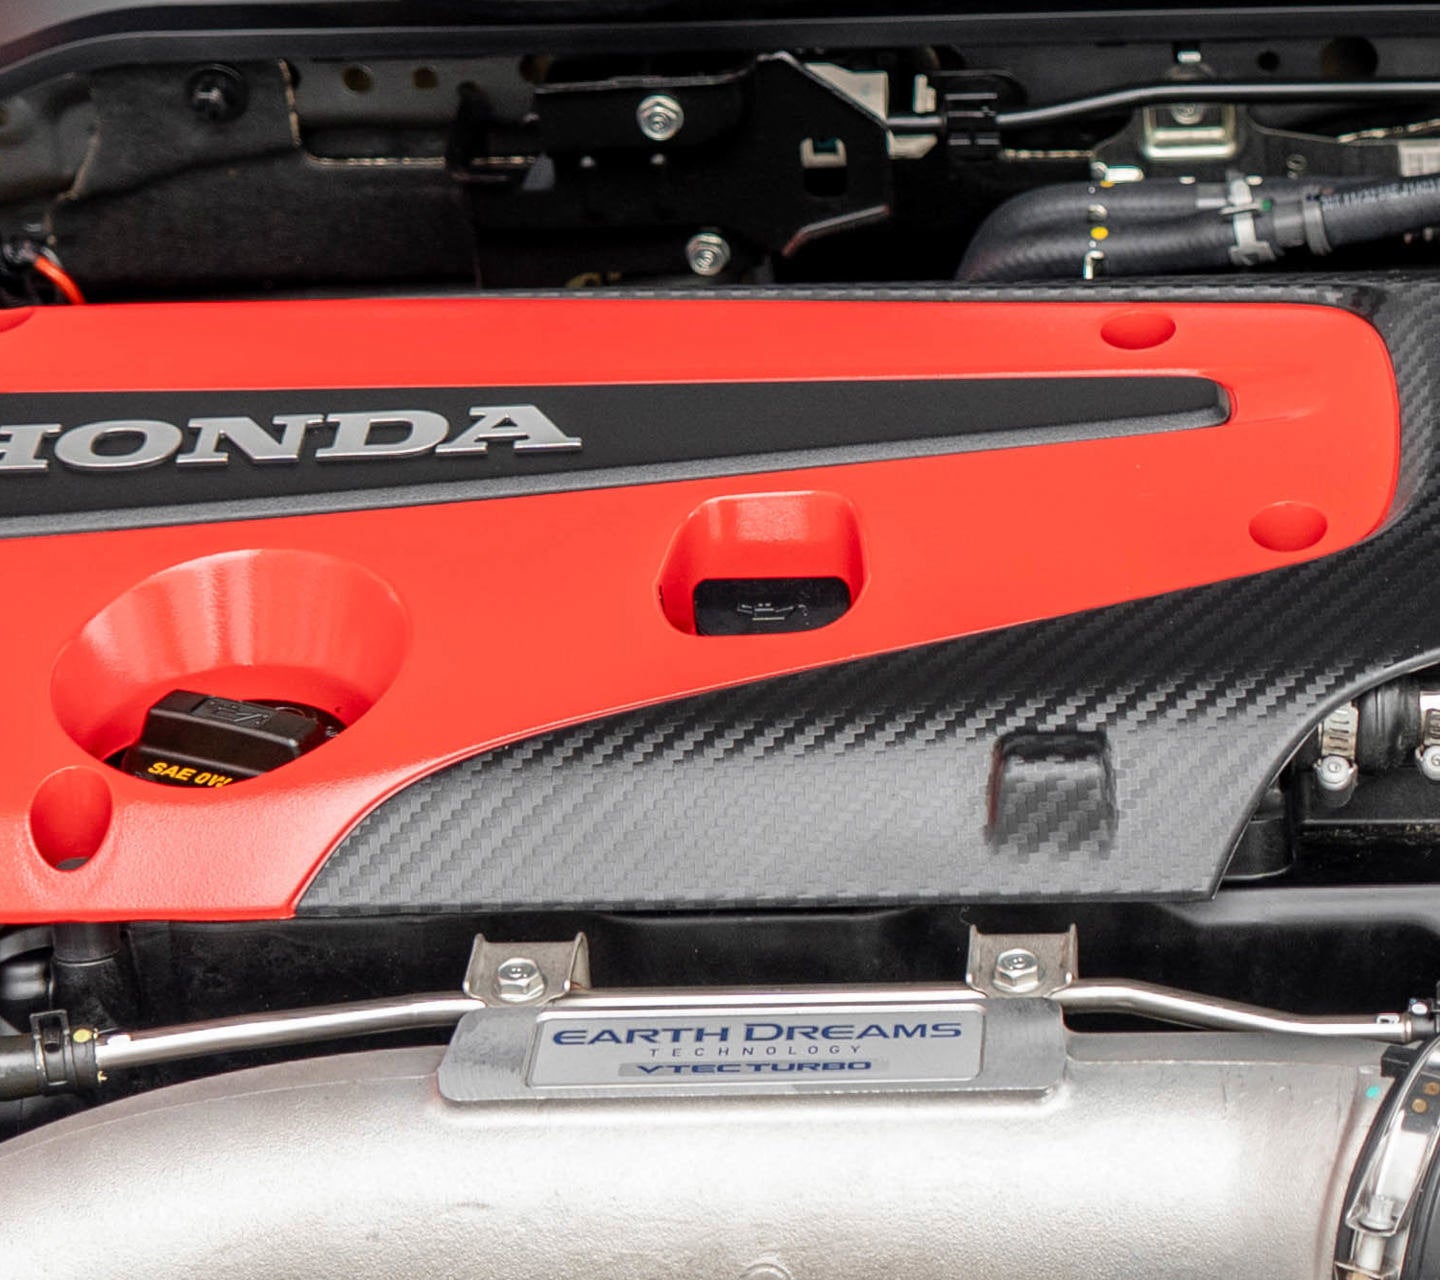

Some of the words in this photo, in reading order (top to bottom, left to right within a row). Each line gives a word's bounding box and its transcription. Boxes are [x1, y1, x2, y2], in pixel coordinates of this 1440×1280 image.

[148, 761, 198, 781] SAE
[552, 1025, 730, 1046] EARTH
[743, 1022, 962, 1042] DREAMS
[651, 1044, 864, 1057] TECHNOLOGY
[635, 1062, 742, 1074] VTEC
[745, 1061, 873, 1072] TURBO
